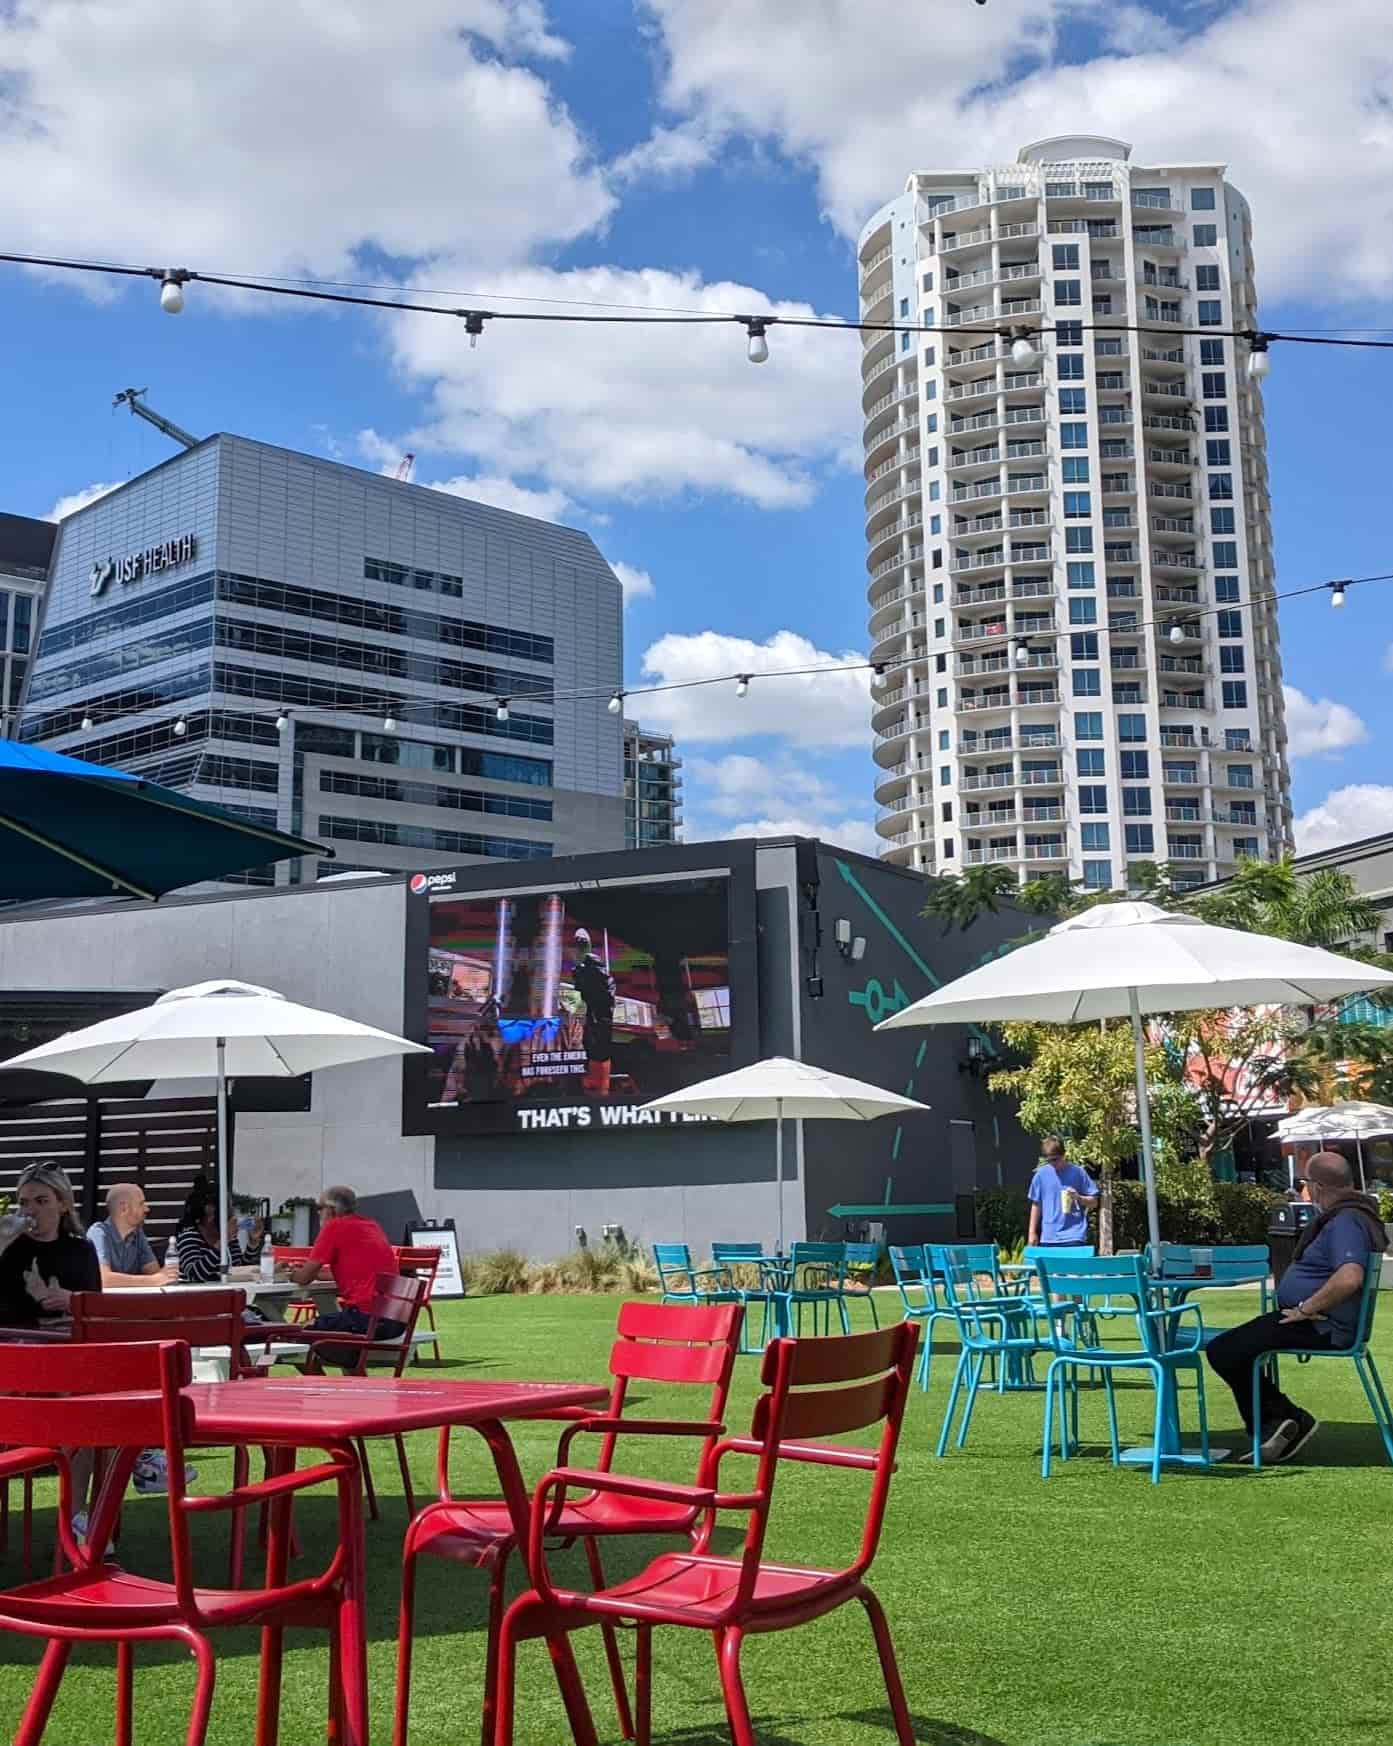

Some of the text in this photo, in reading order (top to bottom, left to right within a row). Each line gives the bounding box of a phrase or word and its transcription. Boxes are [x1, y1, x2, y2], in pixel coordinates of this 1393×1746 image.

[115, 534, 194, 585] USF HEALTH
[428, 872, 456, 887] pepsi
[517, 1106, 591, 1128] THAT'S
